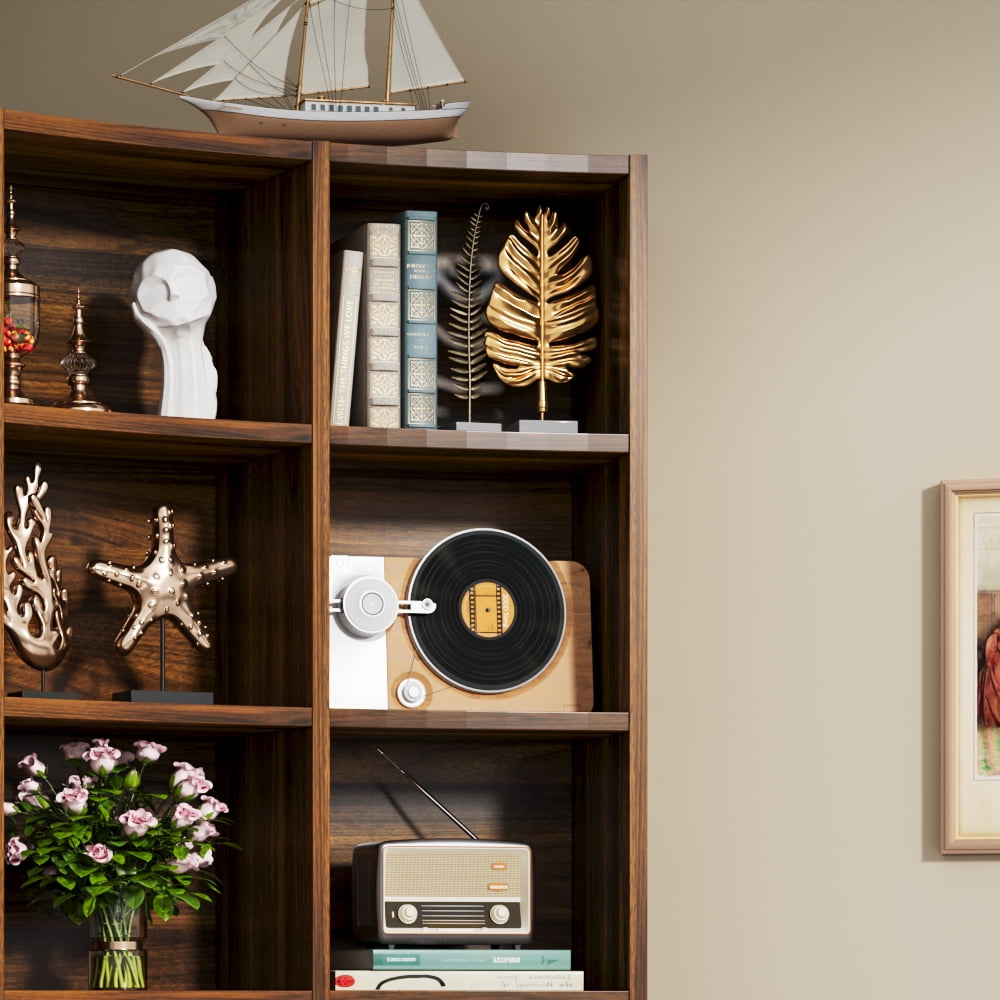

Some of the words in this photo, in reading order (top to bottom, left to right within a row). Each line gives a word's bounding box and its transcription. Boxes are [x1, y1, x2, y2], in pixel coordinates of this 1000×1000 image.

[345, 300, 354, 321] LOVE
[343, 322, 352, 338] WE
[340, 341, 350, 374] THINGS
